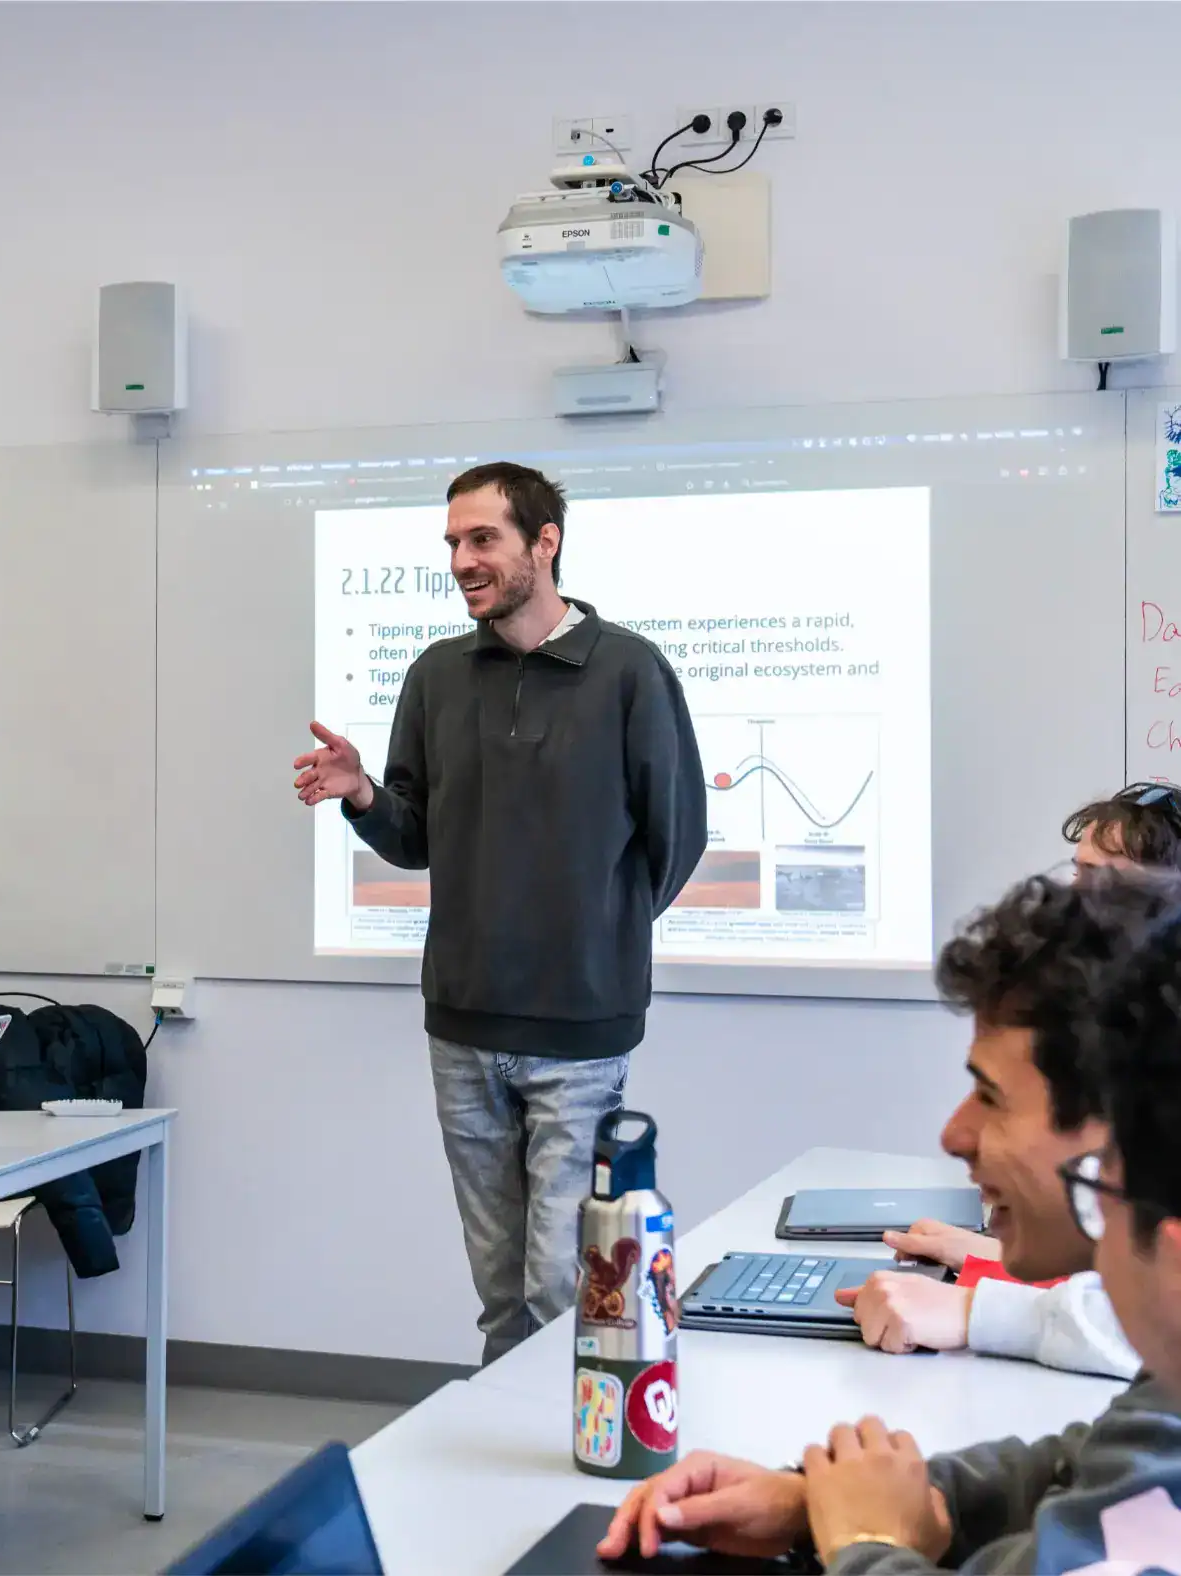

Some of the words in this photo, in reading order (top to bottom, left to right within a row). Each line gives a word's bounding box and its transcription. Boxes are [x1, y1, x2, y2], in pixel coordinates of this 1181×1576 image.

[562, 229, 590, 238] EPSON
[342, 567, 404, 595] 2.1.22
[414, 567, 455, 599] Tipp
[369, 623, 424, 639] Tipping
[428, 621, 475, 638] points
[688, 615, 786, 633] experiences
[792, 617, 800, 628] a
[807, 613, 853, 630] rapid,
[369, 646, 407, 660] often
[693, 640, 744, 654] critical
[751, 637, 843, 652] thresholds.
[688, 663, 748, 681] original
[754, 663, 841, 680] ecosystem
[848, 661, 879, 675] and
